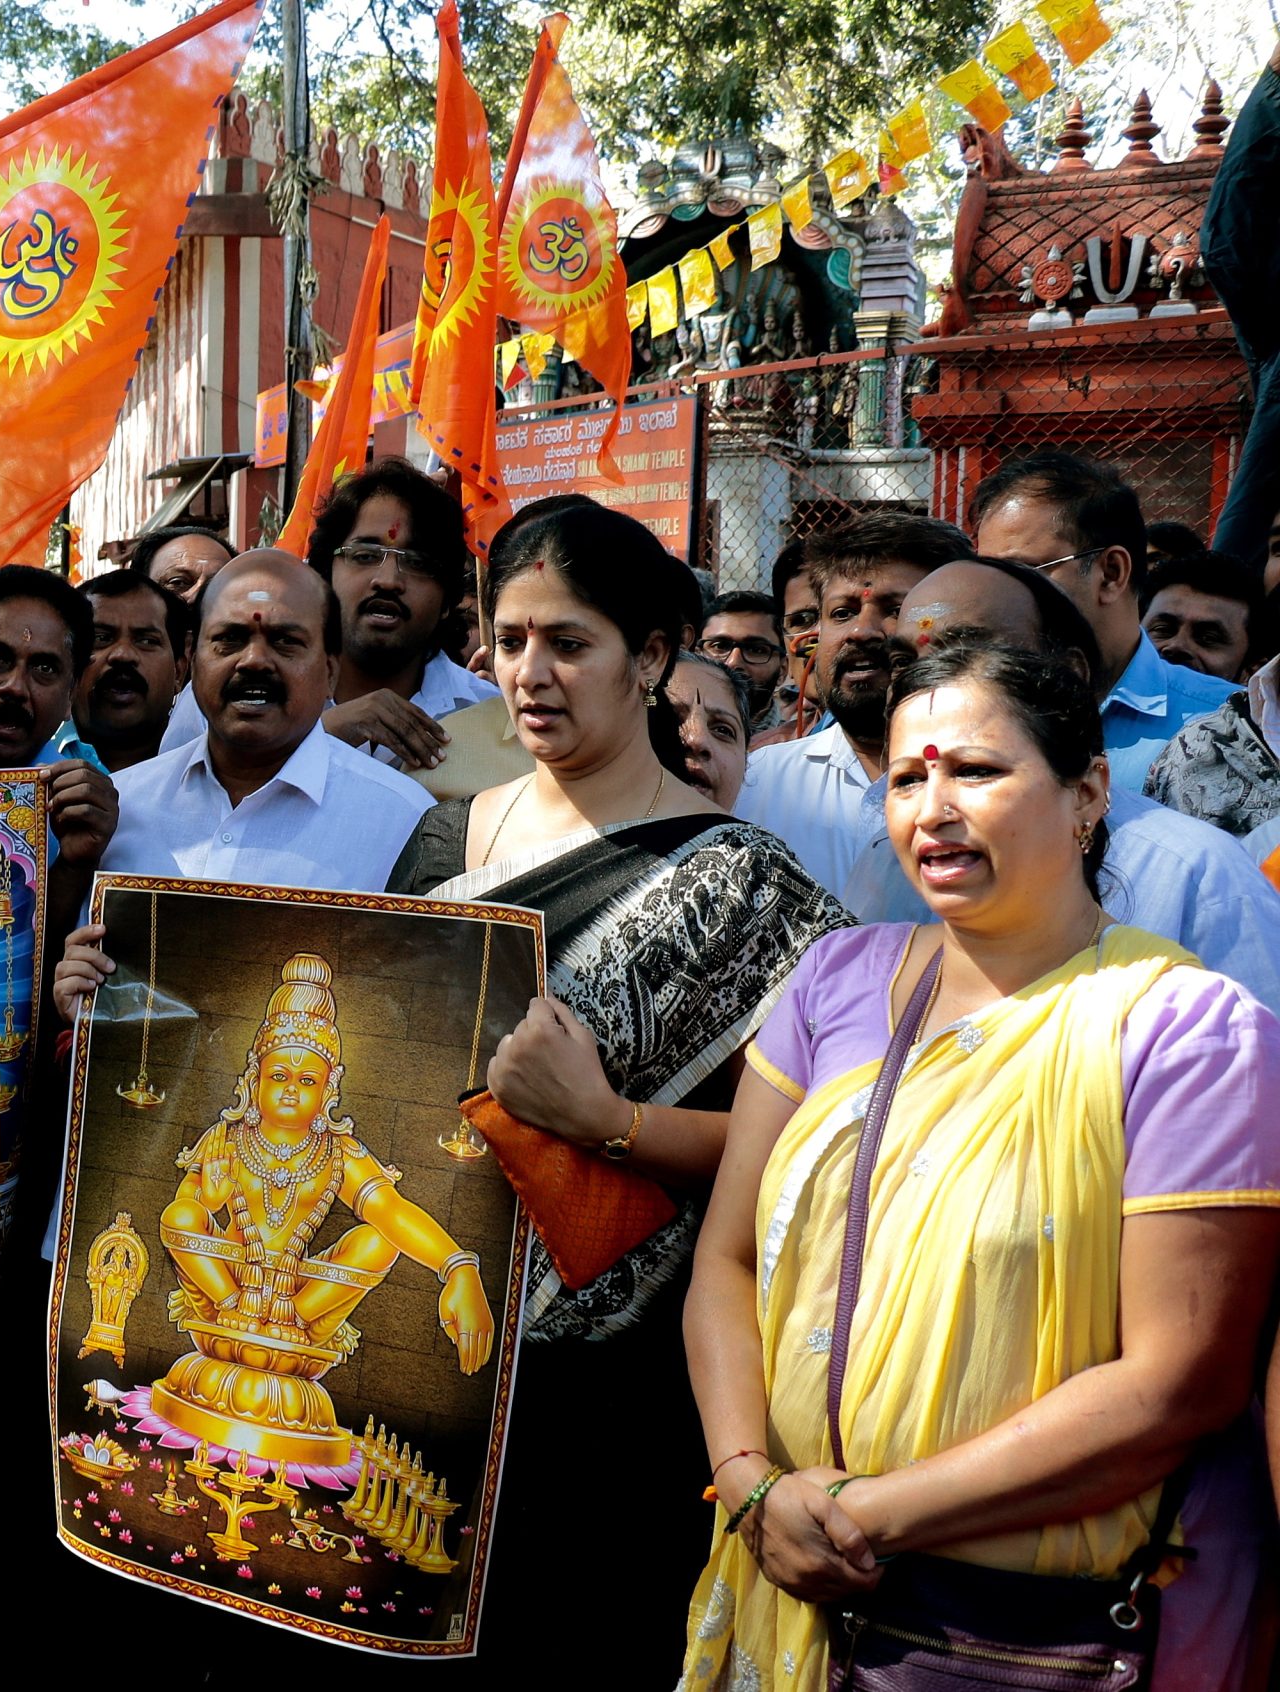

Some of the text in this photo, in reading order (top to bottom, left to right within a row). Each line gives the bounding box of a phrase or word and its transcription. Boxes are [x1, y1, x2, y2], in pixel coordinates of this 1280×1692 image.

[638, 402, 677, 434] ಇಲಾಖೆ
[622, 452, 649, 473] SWAMY
[651, 448, 686, 470] TEMPLE
[659, 481, 689, 503] TEMPLE
